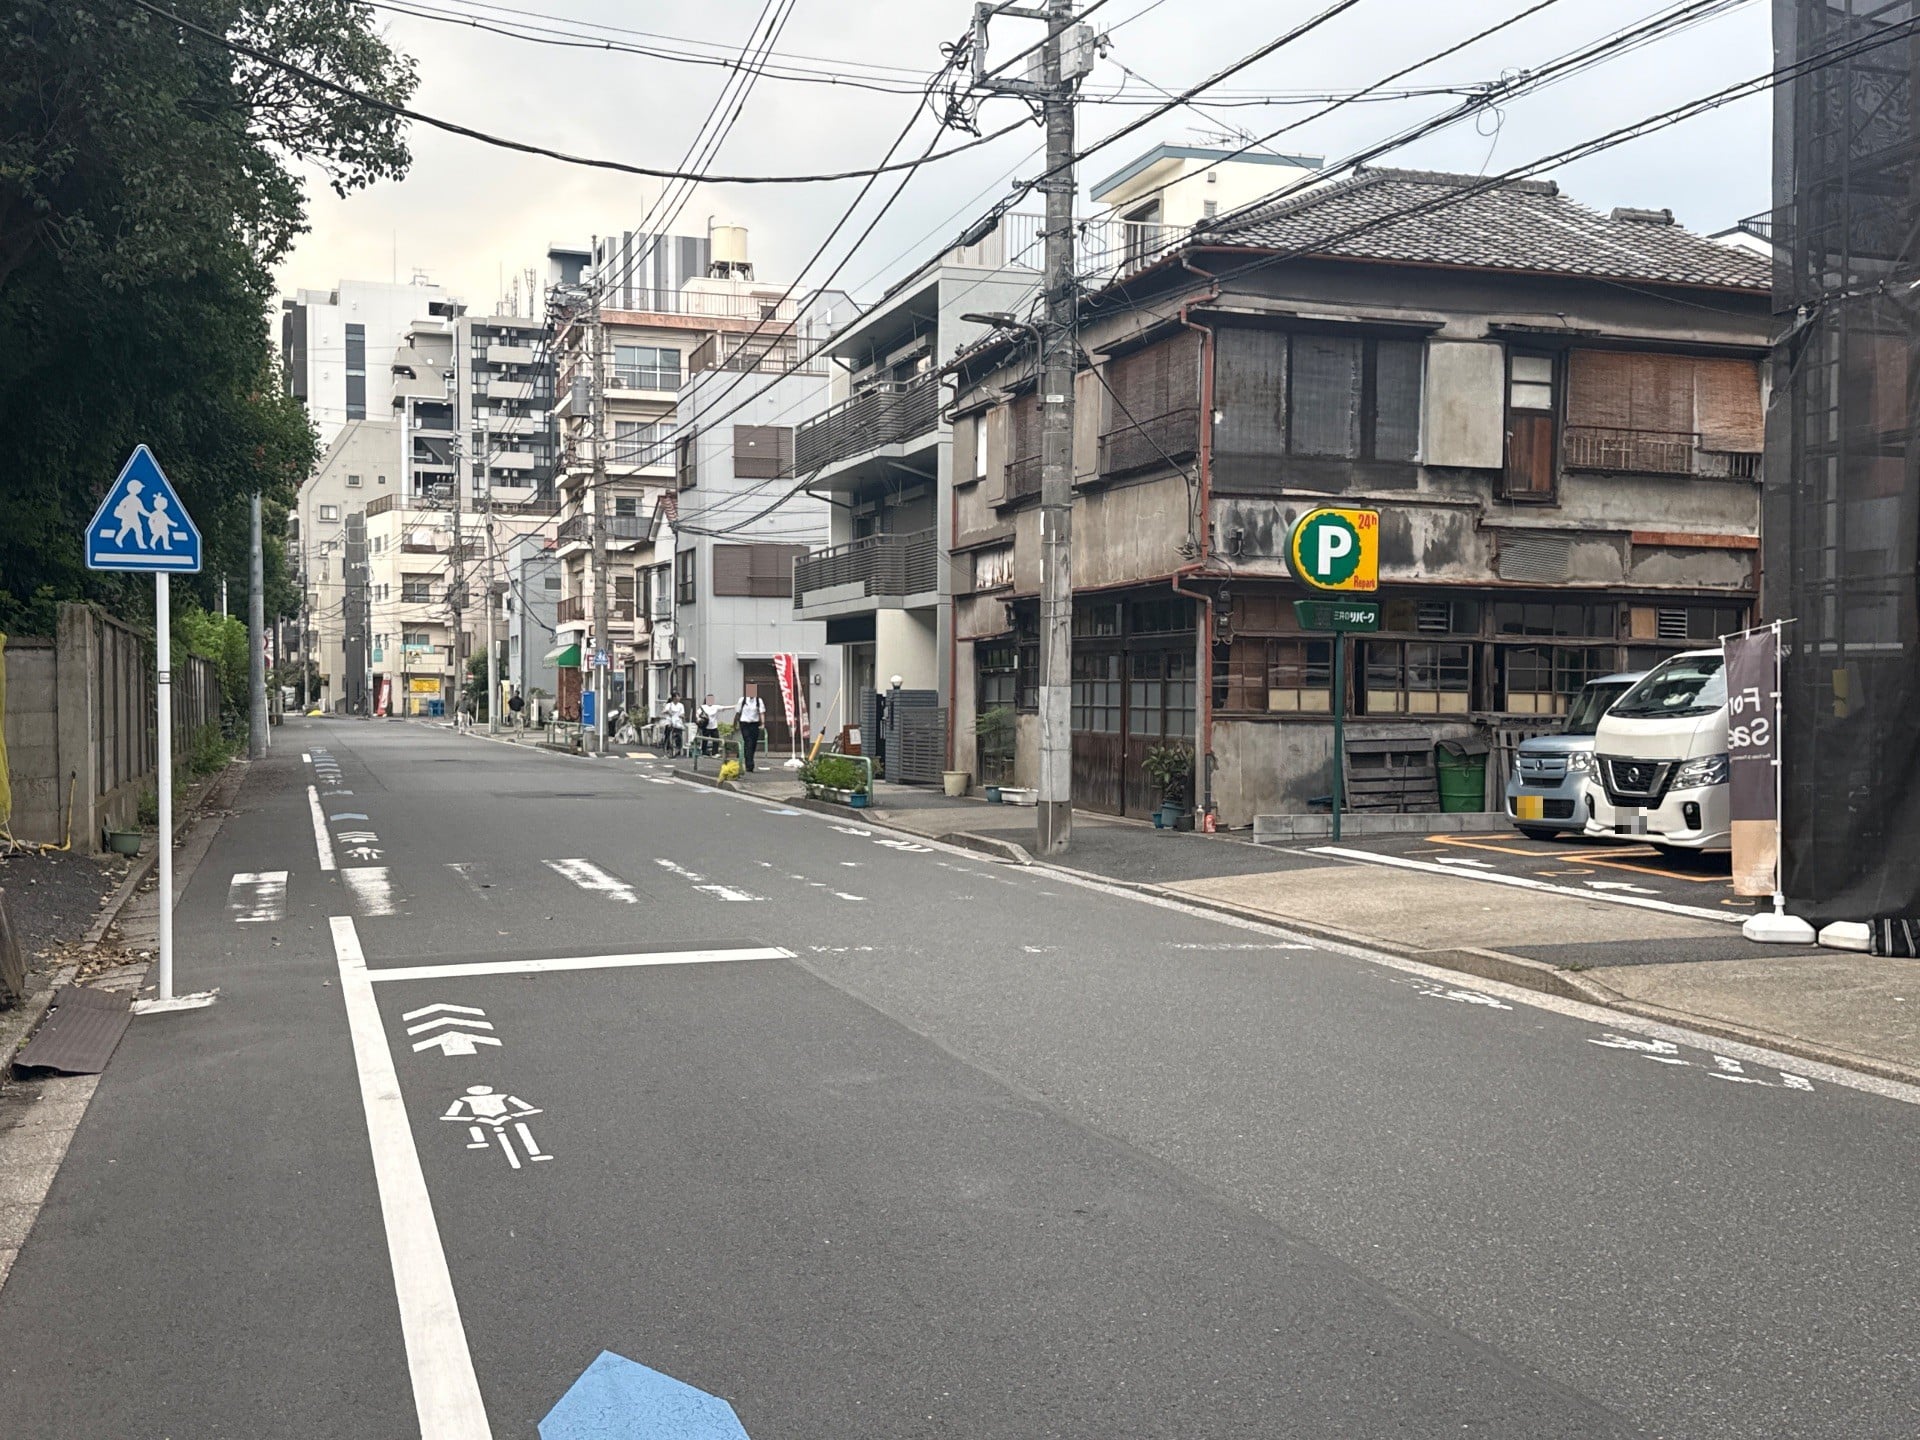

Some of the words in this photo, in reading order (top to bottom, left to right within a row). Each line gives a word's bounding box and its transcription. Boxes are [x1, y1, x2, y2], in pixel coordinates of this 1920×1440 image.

[1359, 514, 1377, 529] 24h
[1318, 525, 1352, 577] P
[1353, 575, 1376, 588] Repark
